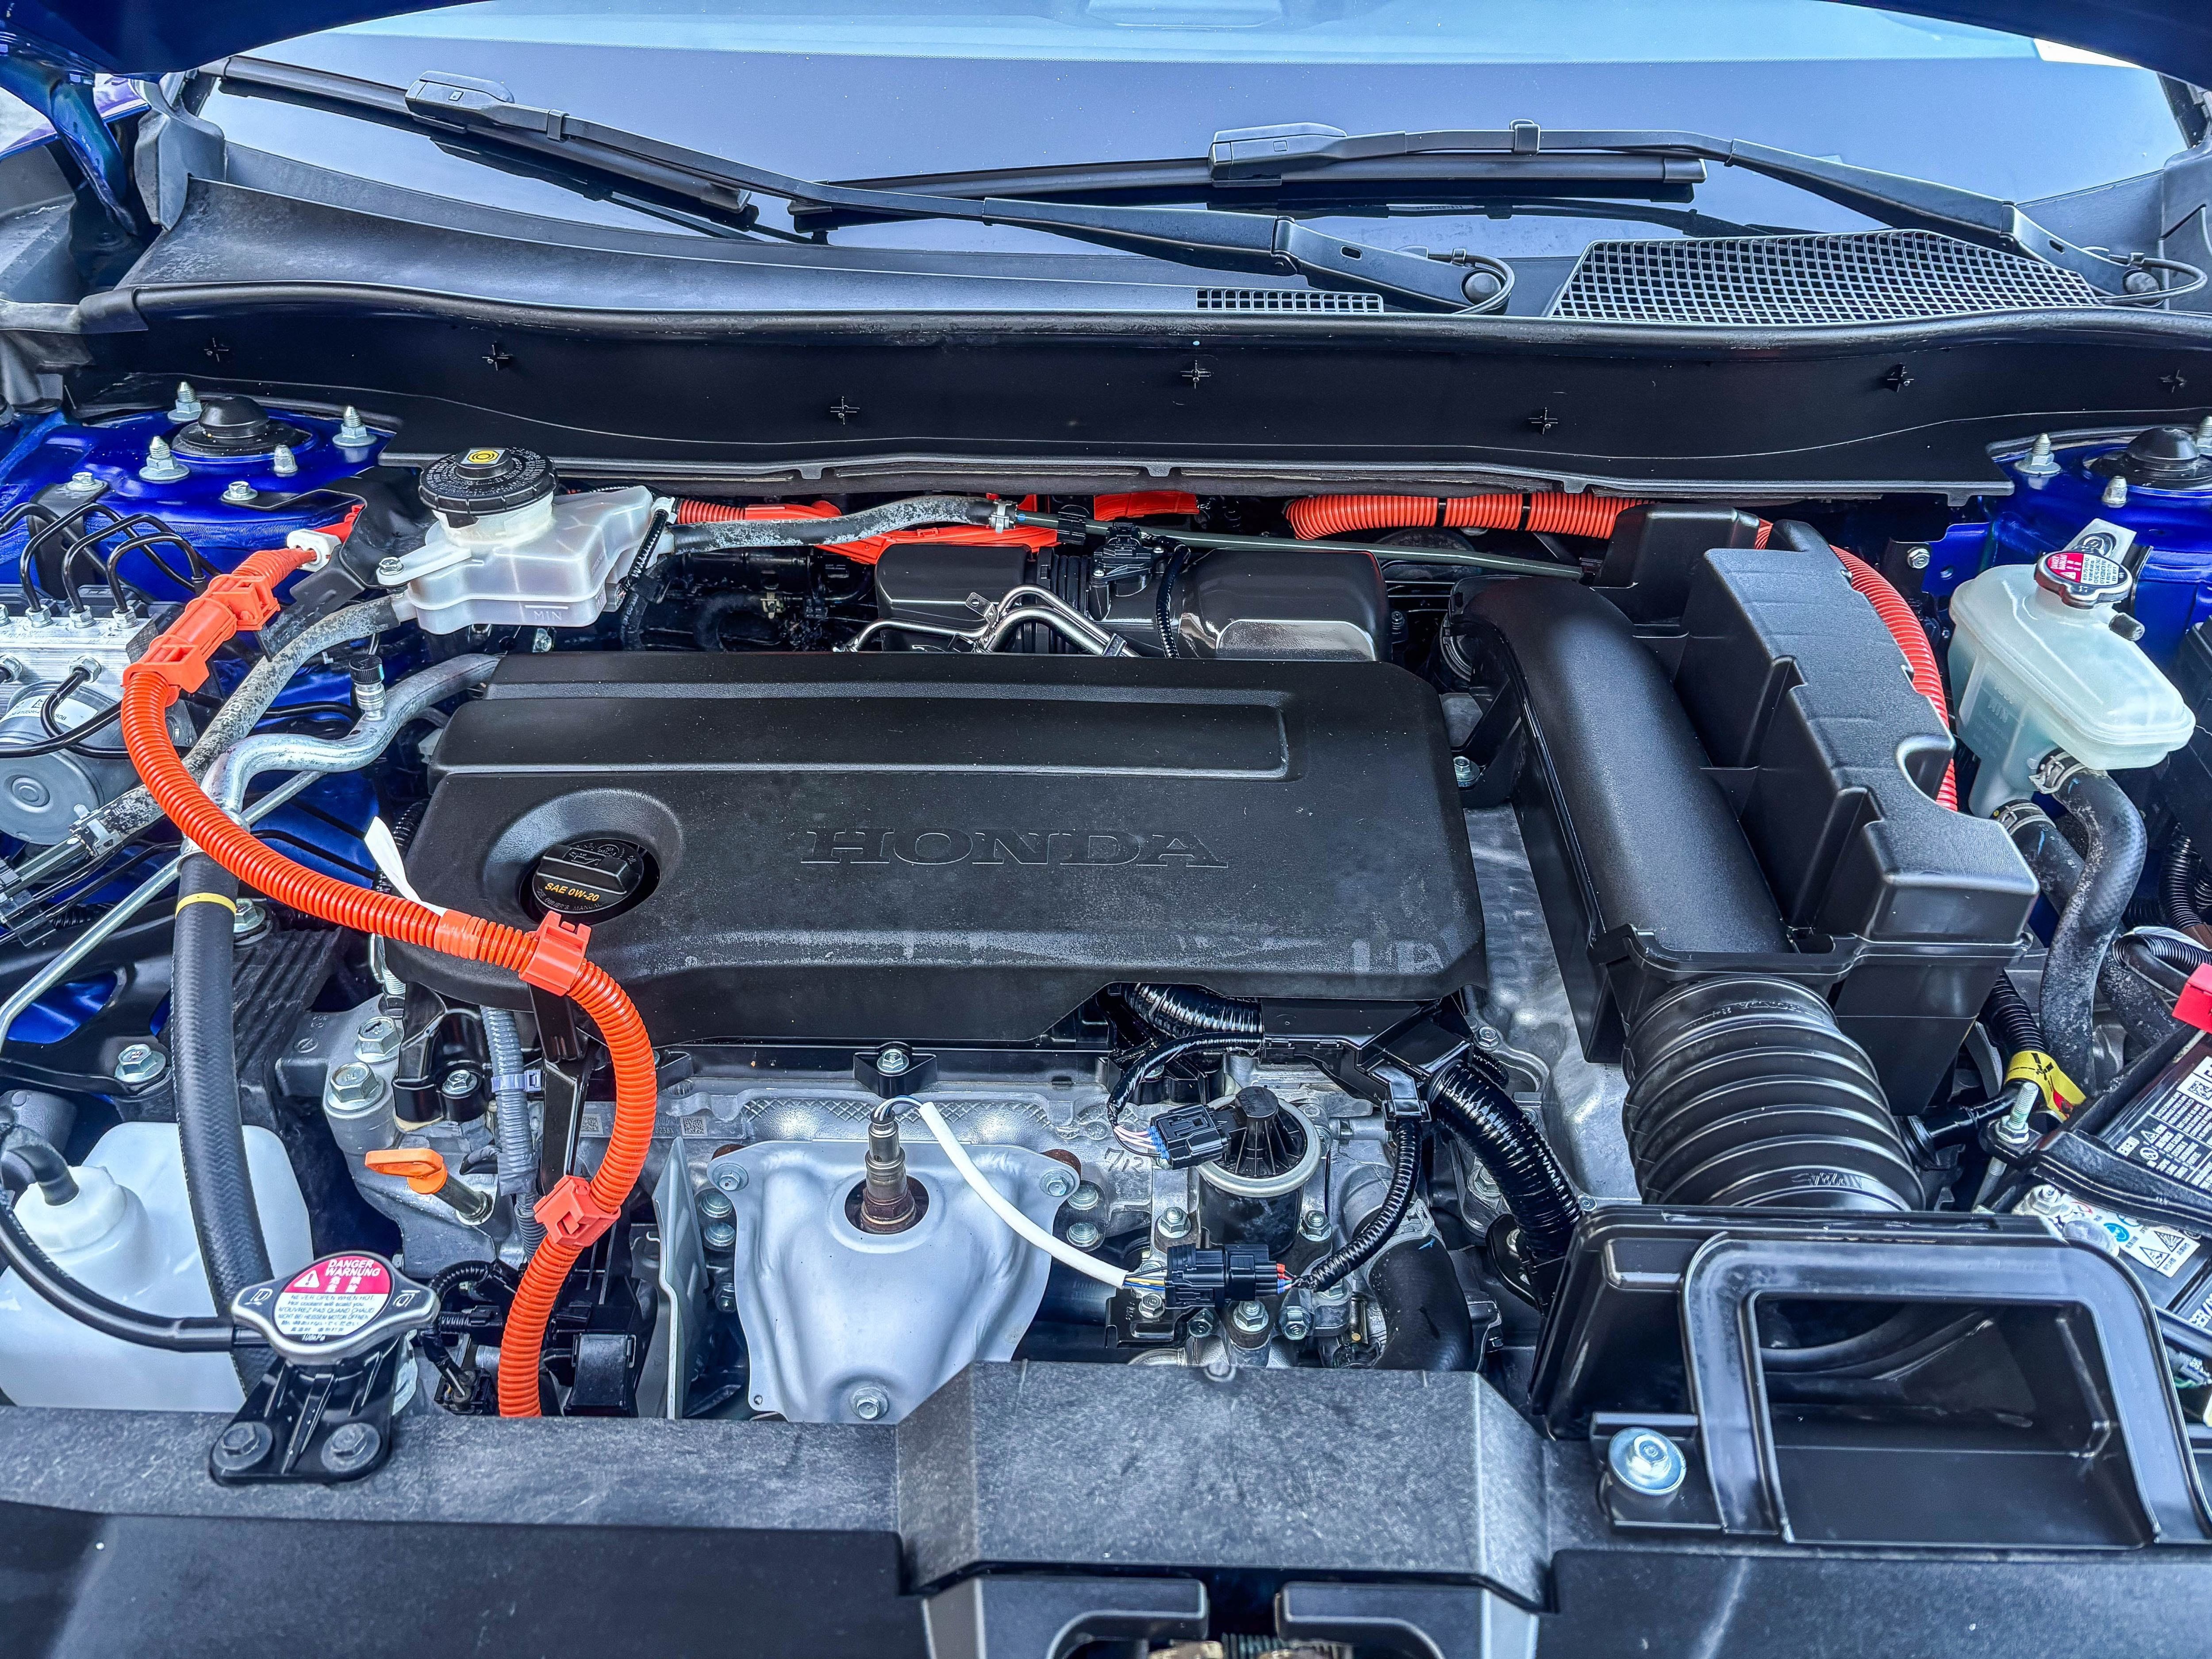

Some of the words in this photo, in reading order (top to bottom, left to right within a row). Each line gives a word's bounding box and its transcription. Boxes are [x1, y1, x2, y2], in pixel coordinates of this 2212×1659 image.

[800, 828, 1229, 868] HONDA
[545, 882, 568, 895] SAE
[568, 888, 600, 902] 0W-20
[545, 897, 570, 910] OWNER'S
[573, 902, 603, 911] MANUAL
[328, 1259, 375, 1268] DANGER
[325, 1267, 381, 1277] WARNUNG
